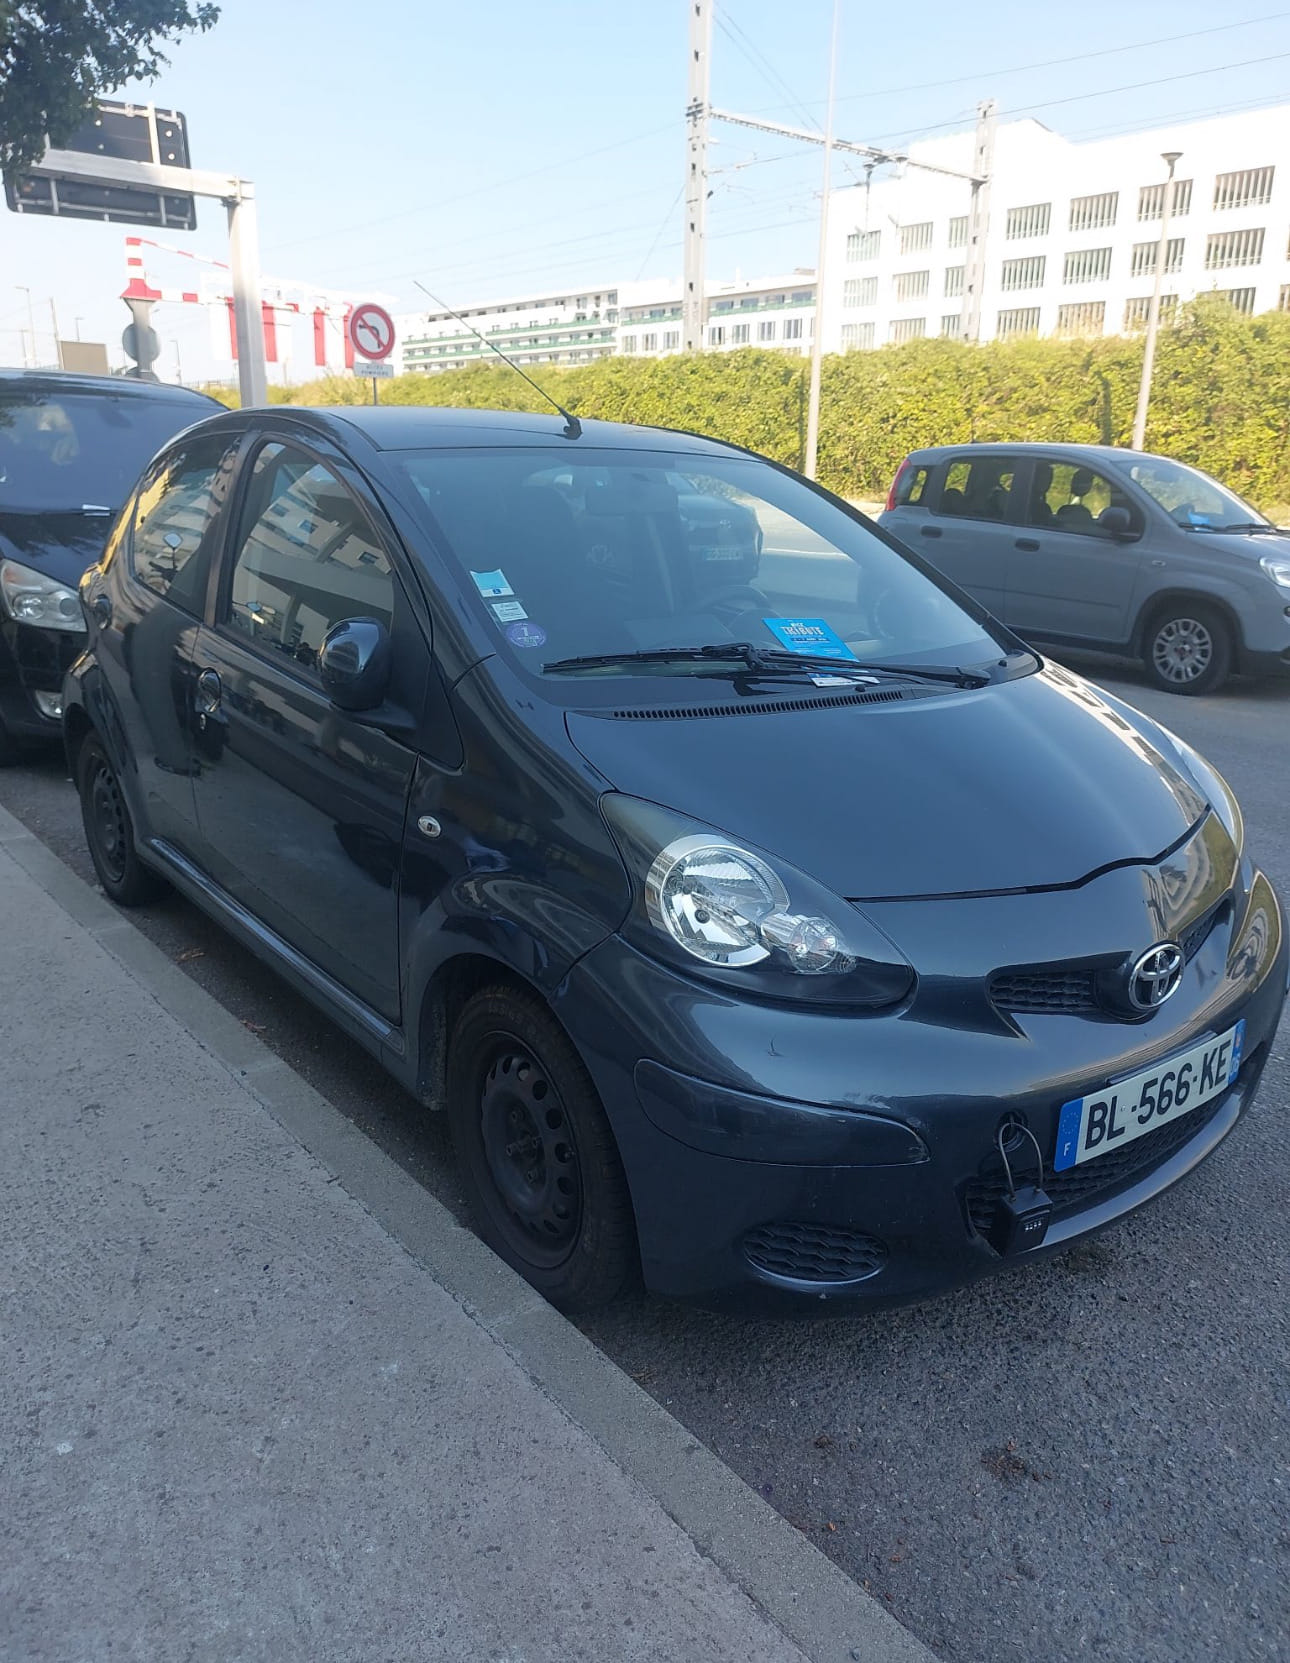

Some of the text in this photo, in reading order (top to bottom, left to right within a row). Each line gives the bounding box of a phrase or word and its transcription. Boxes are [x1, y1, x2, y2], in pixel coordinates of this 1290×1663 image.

[780, 626, 824, 635] TRIBUTE
[1063, 1141, 1071, 1157] F
[1085, 1040, 1232, 1150] BL-566-KE
